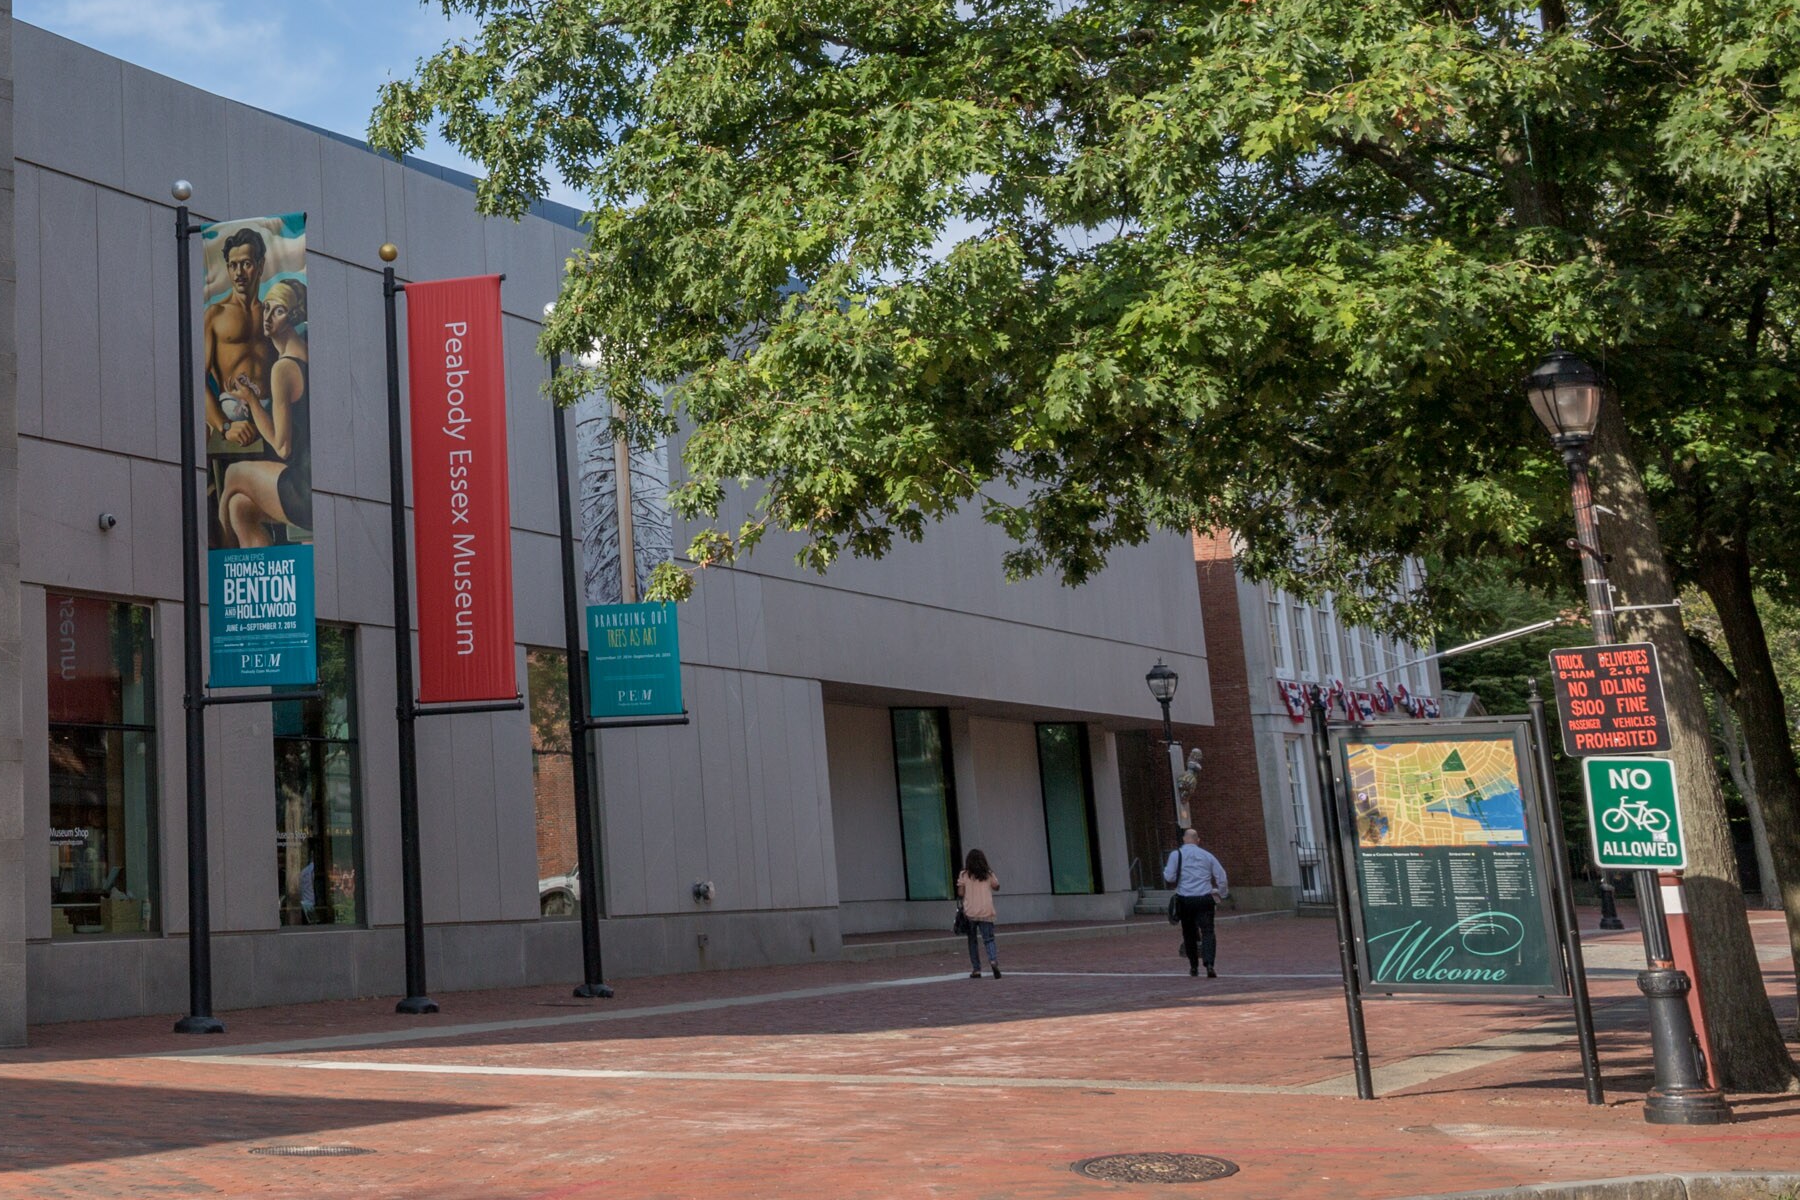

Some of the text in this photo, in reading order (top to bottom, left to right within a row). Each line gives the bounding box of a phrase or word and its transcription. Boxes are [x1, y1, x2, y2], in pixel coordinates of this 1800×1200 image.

[443, 321, 476, 656] Peabody Essex Museum
[224, 553, 265, 562] AMERICAN EPICS
[224, 559, 295, 578] THOMAS HART
[224, 575, 296, 605] BENTON
[224, 602, 296, 619] AND HOLLYWOOD
[595, 610, 667, 628] BRANCHING OUT
[226, 624, 239, 632] JUNE
[284, 621, 297, 629] 2015
[607, 627, 657, 648] TREES AS ART
[1555, 650, 1648, 670] TRUCK DELIVERIES
[1635, 665, 1650, 674] PM
[1567, 677, 1646, 697] NO IDLING
[1571, 697, 1649, 717] $100 FINE
[1568, 715, 1657, 730] PASSENGER VEHICLES
[1575, 730, 1657, 749] PROHIBITED
[1608, 768, 1652, 790] NO
[49, 827, 88, 839] Museum Shop
[1602, 841, 1678, 857] ALLOWED
[1368, 911, 1524, 983] Welcome
